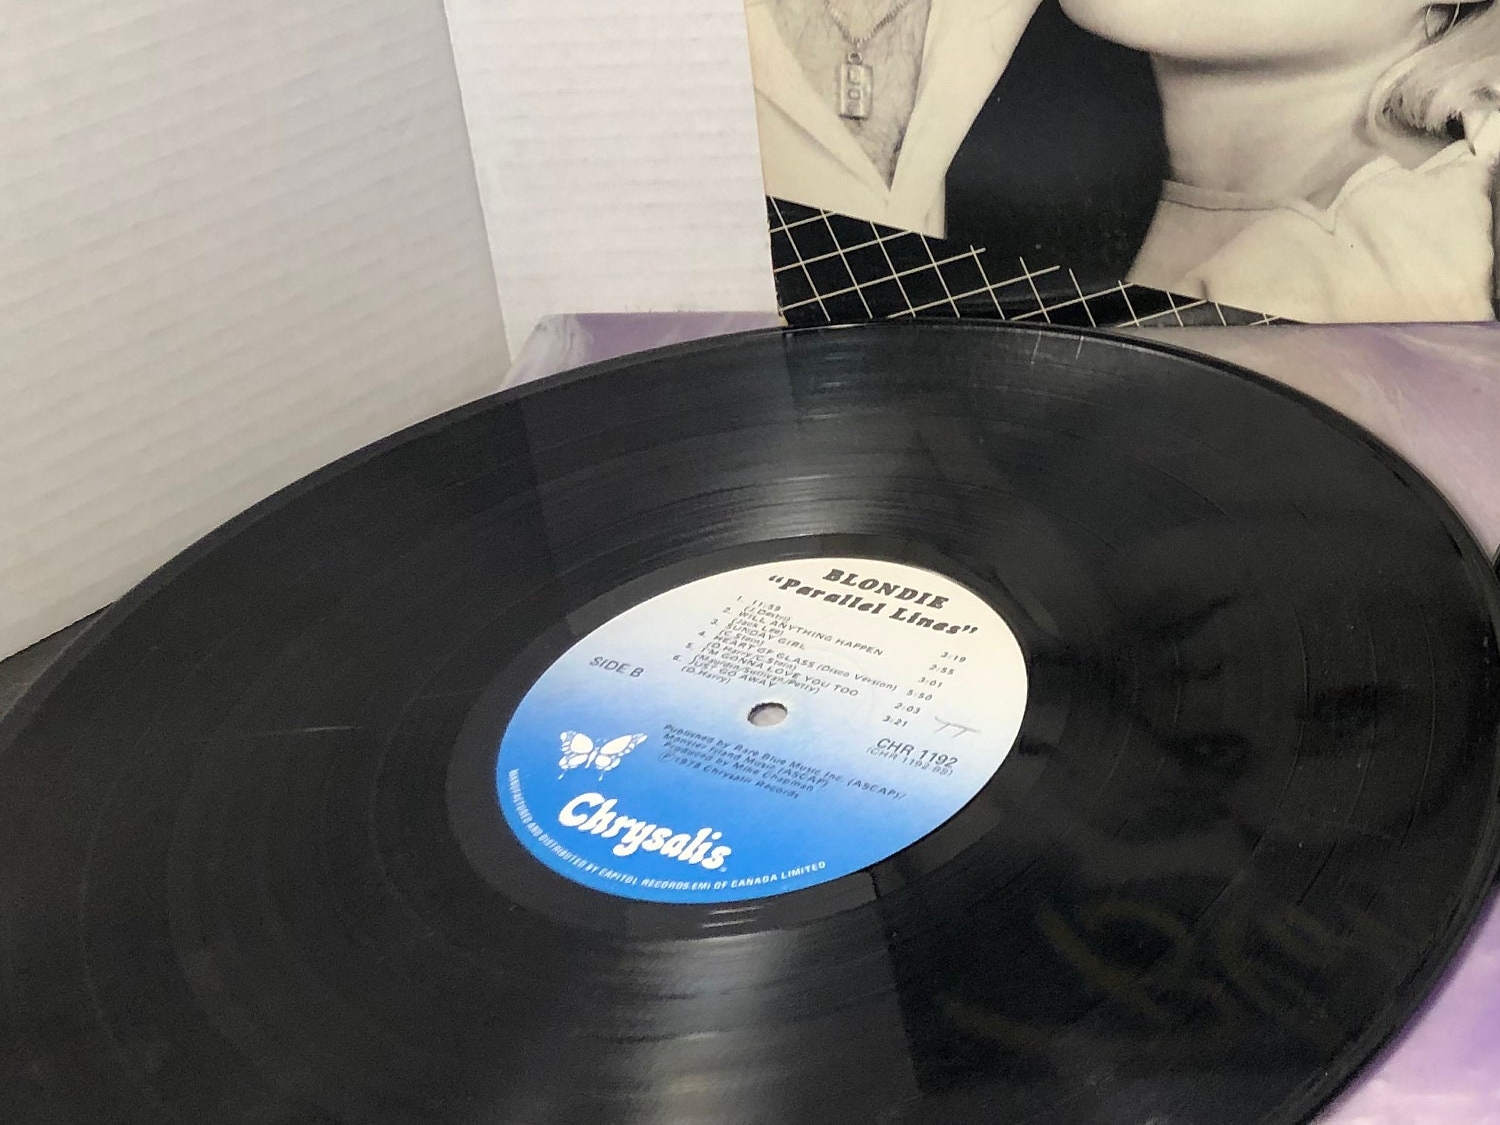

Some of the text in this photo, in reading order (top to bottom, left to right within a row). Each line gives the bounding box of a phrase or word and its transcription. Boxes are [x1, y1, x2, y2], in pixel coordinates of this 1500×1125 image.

[823, 568, 949, 609] BLONDIE
[590, 656, 644, 677] SIDE B
[713, 636, 753, 650] HEART
[776, 653, 816, 668] GLASS
[854, 674, 898, 691] Version)
[906, 690, 933, 701] 5:50
[726, 624, 776, 640] SUNDAY
[778, 638, 806, 650] GIRL
[918, 677, 943, 688] 3:01
[769, 620, 832, 642] ANYTHING
[835, 638, 883, 656] HAPPEN
[929, 664, 954, 675] 2:55
[941, 651, 967, 662] 3:19
[721, 653, 764, 669] GONNA
[767, 667, 801, 678] LOVE
[805, 676, 831, 688] YOU
[834, 685, 859, 696] TOO
[894, 703, 921, 714] 2:03
[739, 673, 778, 688] AWAY
[882, 715, 908, 727] 3:21
[876, 738, 958, 768] CHR 1192
[558, 792, 732, 870] Chrysalis
[598, 868, 638, 885] CAPITOL
[713, 881, 727, 890] OF
[731, 874, 778, 888] CANADA
[781, 861, 826, 879] LIMITED
